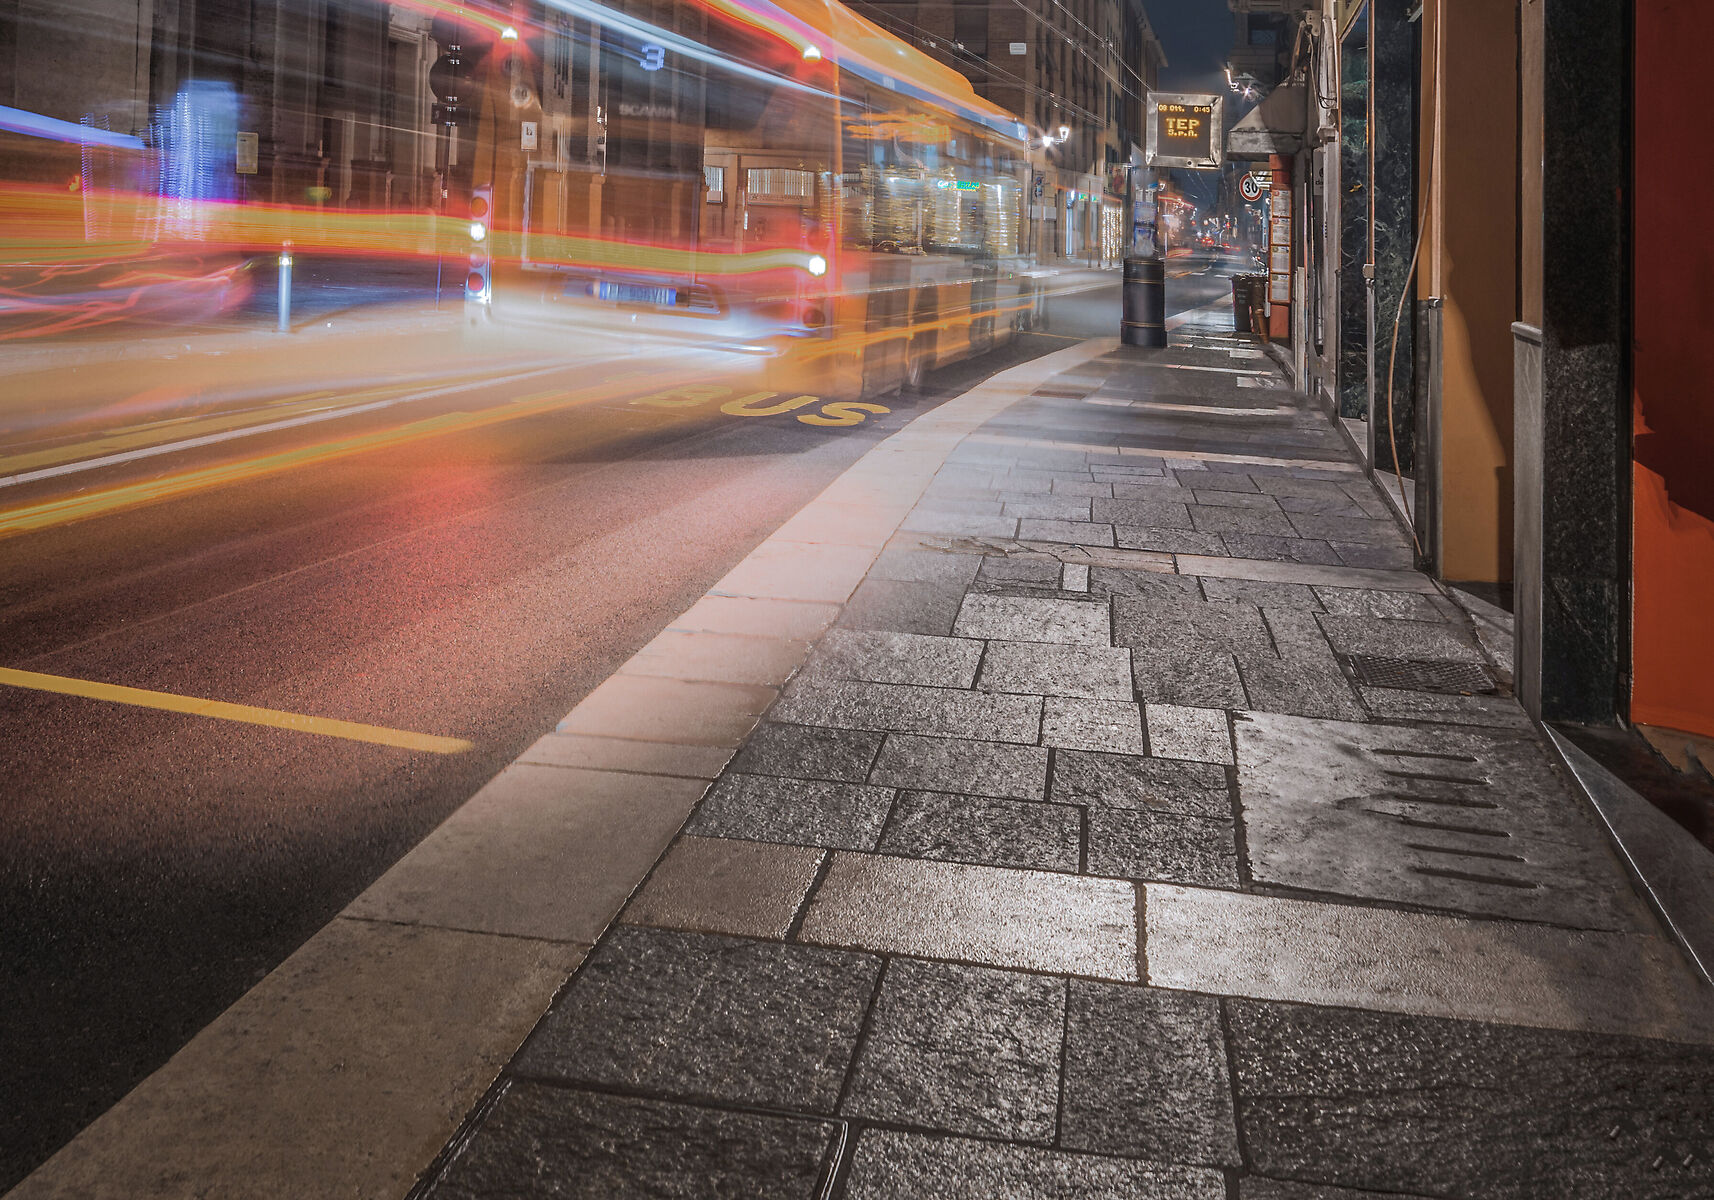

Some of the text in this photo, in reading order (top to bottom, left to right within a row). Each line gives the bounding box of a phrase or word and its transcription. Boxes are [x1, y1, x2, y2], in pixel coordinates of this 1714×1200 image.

[640, 44, 665, 71] 3
[1165, 118, 1200, 129] TEP
[1245, 181, 1258, 193] 30
[628, 384, 891, 427] BUS
